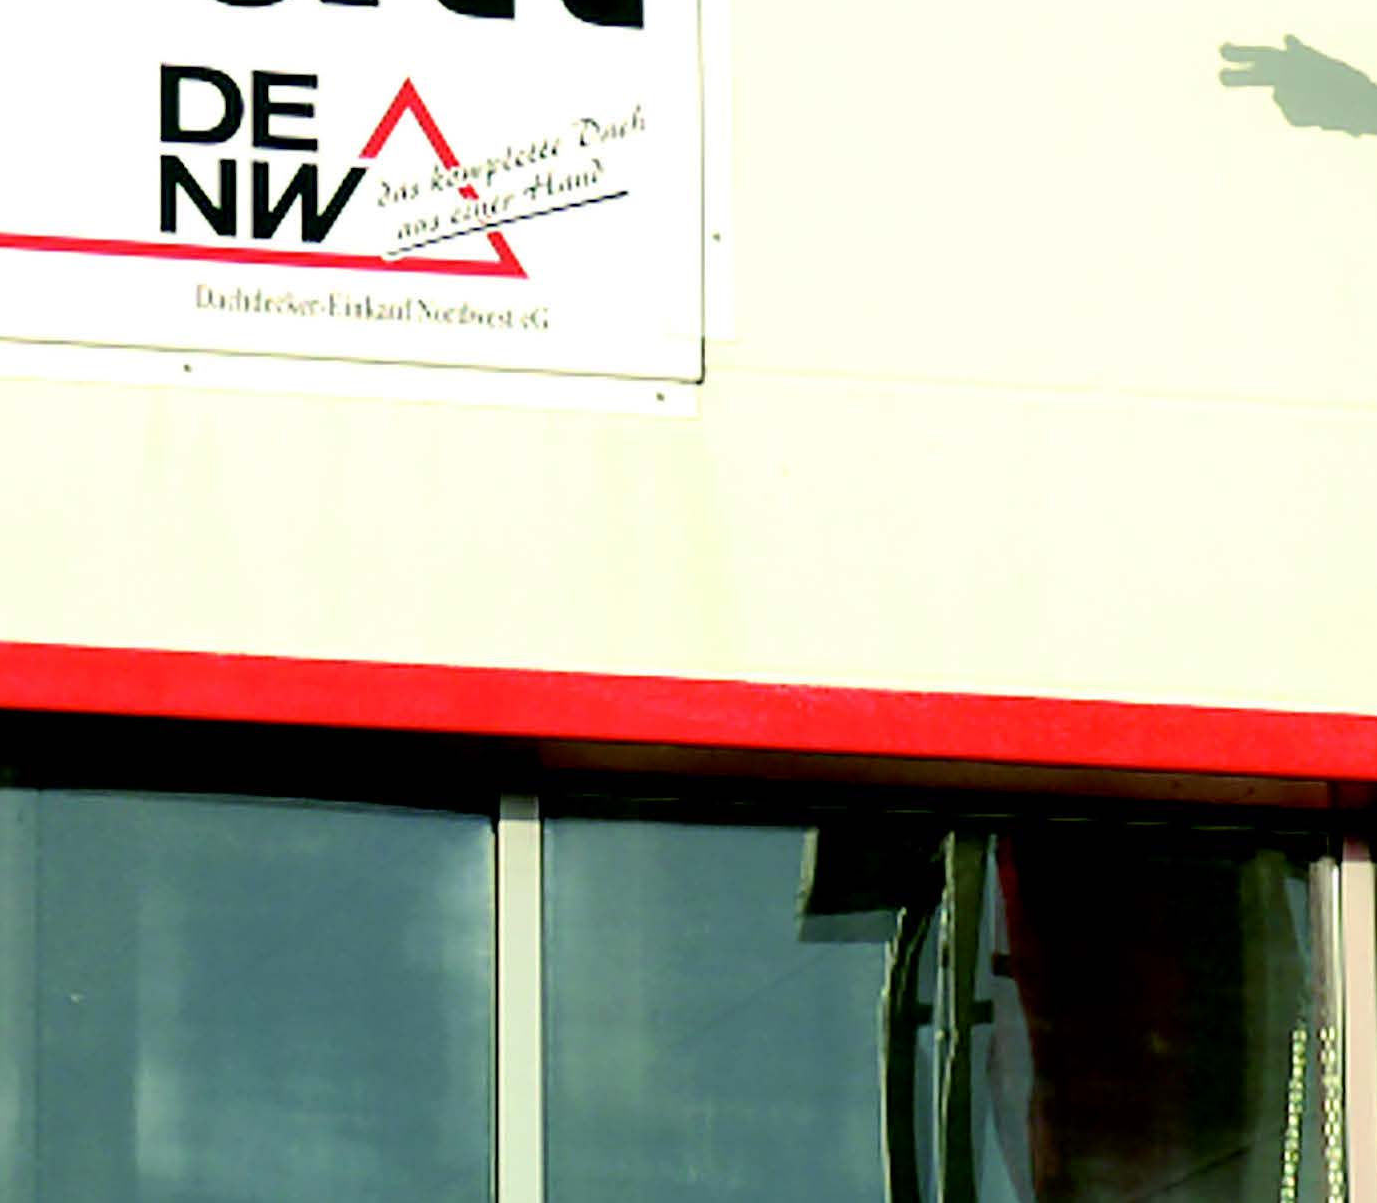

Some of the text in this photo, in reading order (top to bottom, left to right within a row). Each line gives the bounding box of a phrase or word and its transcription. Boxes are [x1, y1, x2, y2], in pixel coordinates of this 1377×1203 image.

[160, 64, 318, 152] DE
[160, 154, 367, 244] NW
[377, 181, 419, 208] das
[572, 103, 646, 147] Dach
[524, 158, 604, 200] Hand
